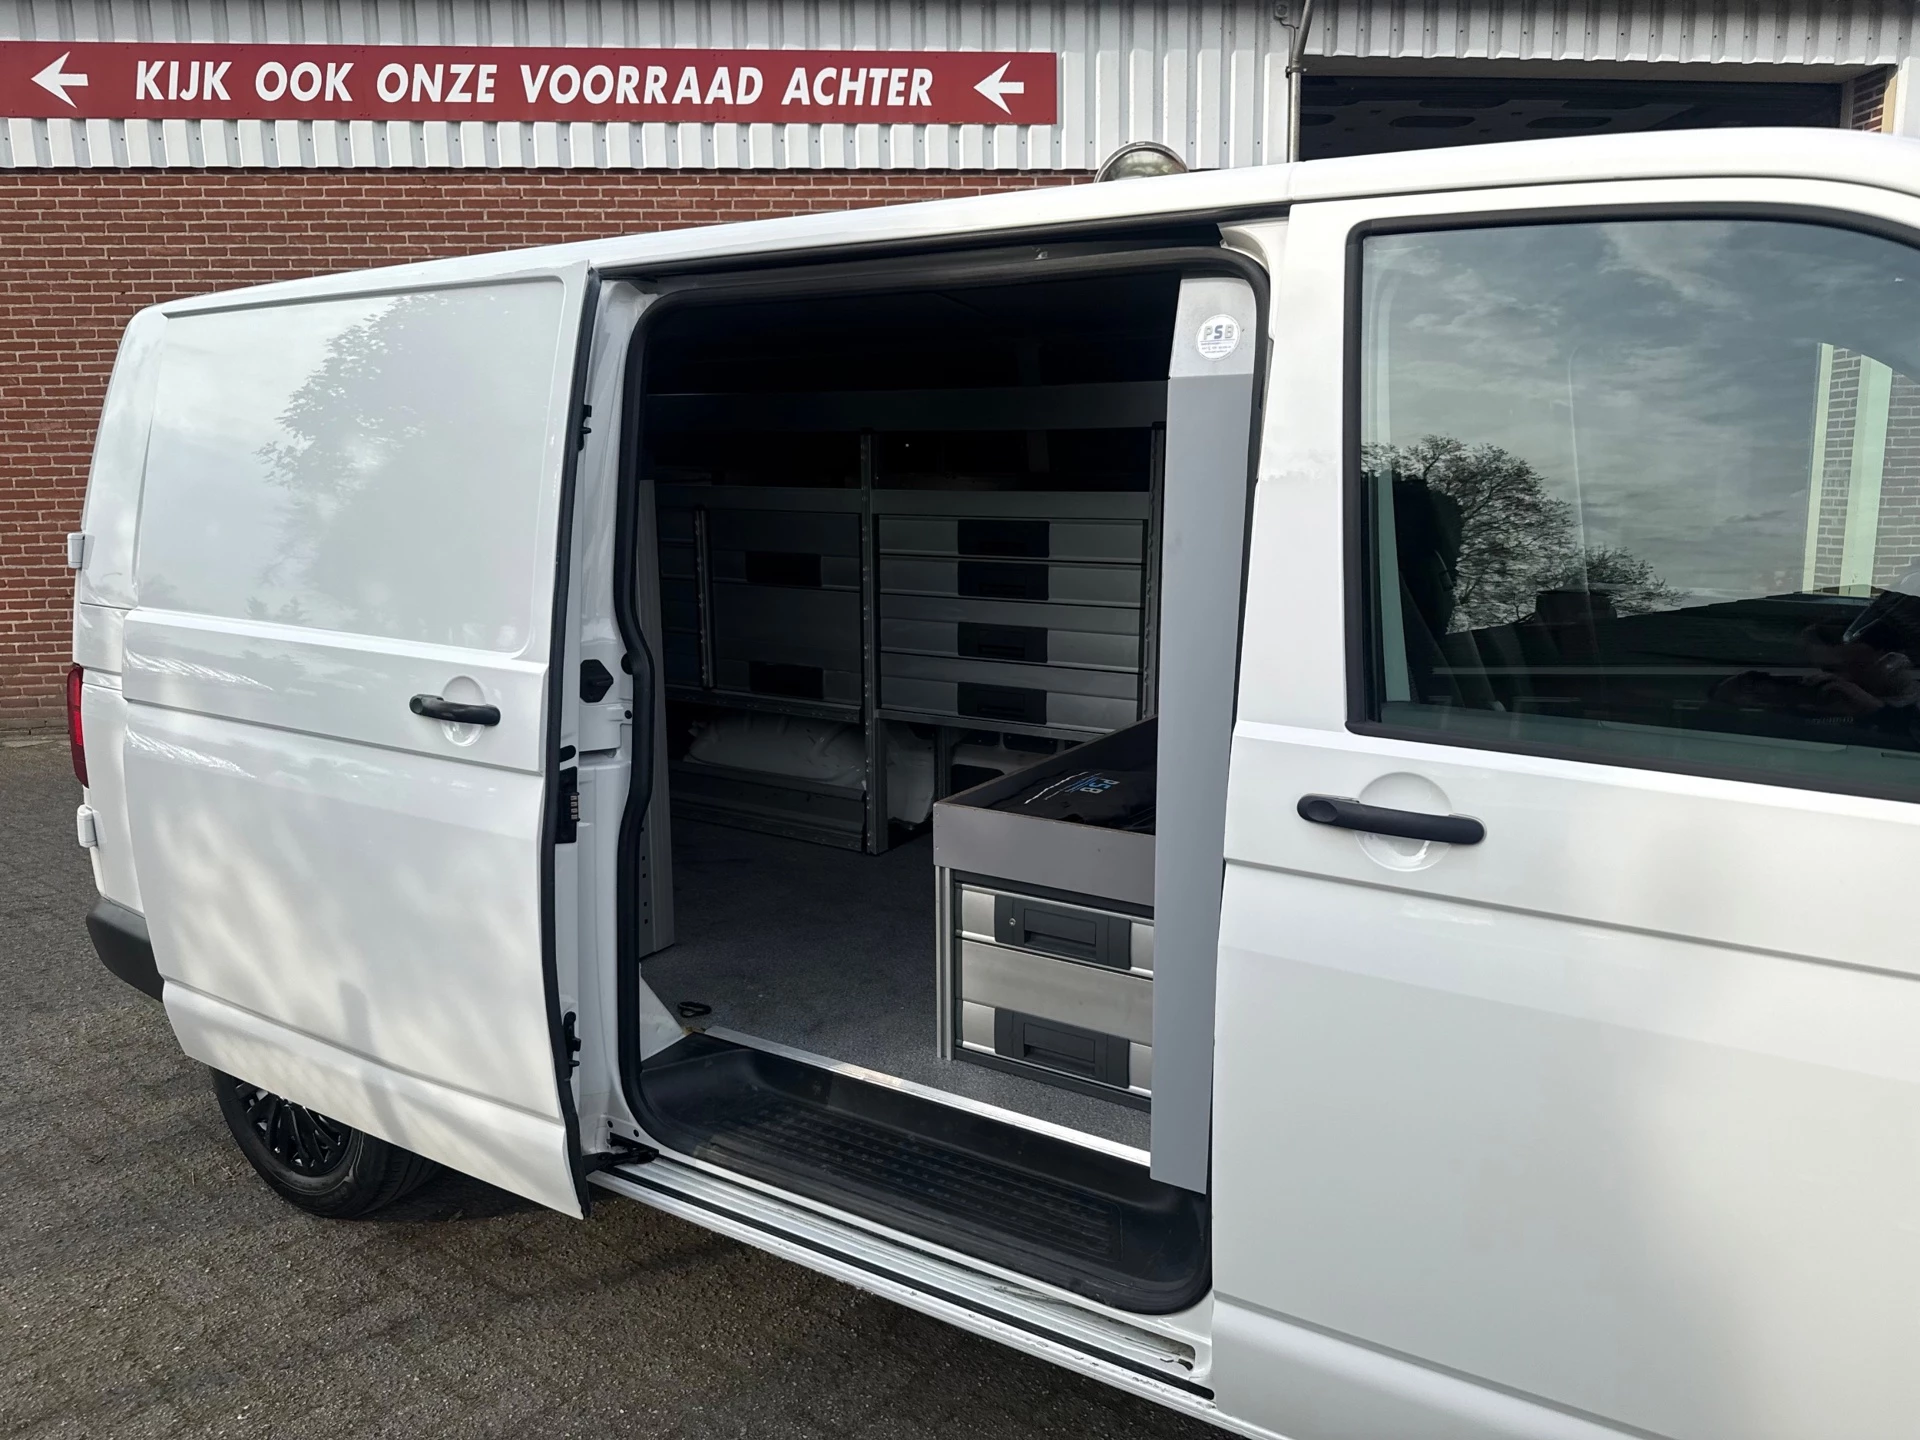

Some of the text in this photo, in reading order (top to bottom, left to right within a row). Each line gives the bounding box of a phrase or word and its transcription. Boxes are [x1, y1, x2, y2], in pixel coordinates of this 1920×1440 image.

[135, 60, 933, 106] KIJK OOK ONZE VOORRAAD ACHTER
[1203, 324, 1235, 340] PSB
[1080, 778, 1120, 794] PSB
